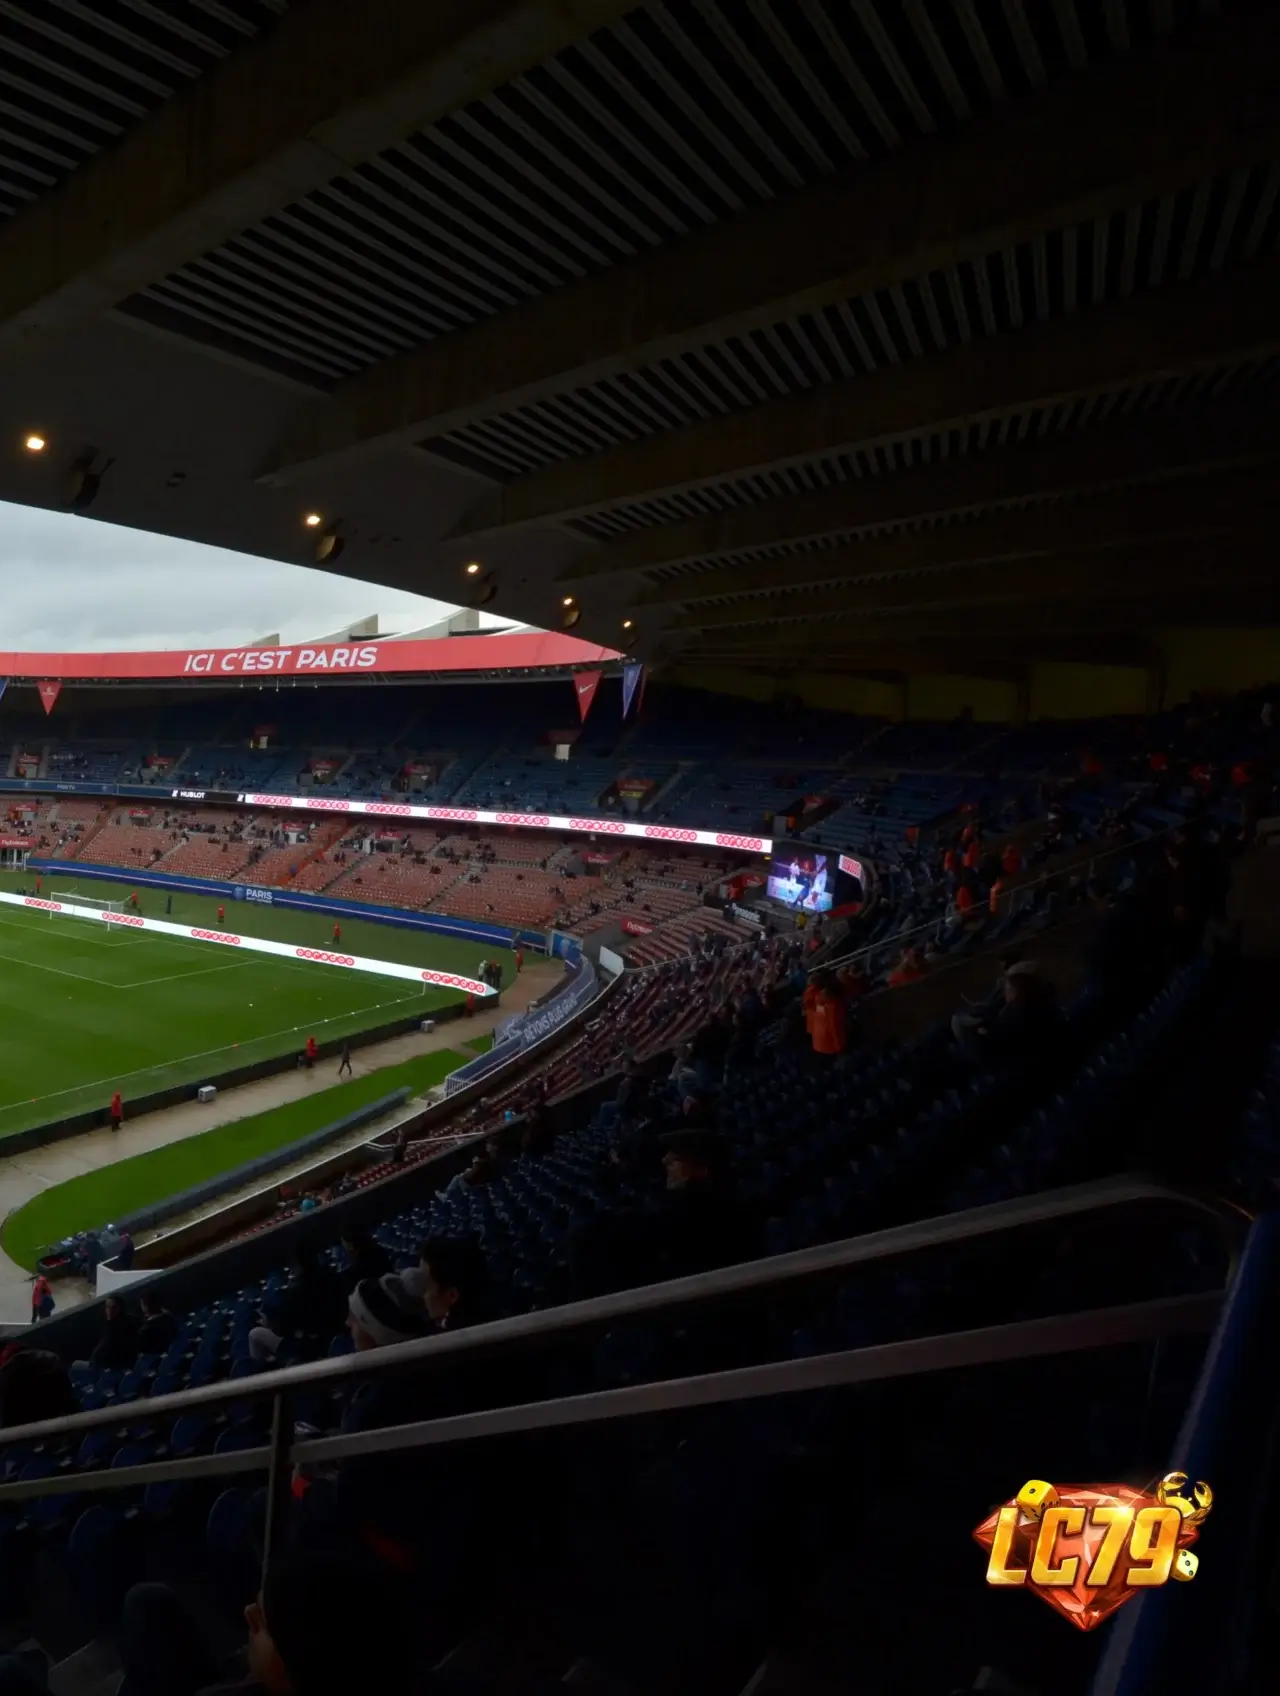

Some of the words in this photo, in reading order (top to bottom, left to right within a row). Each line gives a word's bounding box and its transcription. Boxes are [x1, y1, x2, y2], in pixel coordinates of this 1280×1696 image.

[183, 653, 216, 673] ICI
[220, 650, 292, 672] C'EST
[295, 646, 379, 669] PARIS
[180, 790, 205, 799] HUBLOT
[245, 887, 273, 900] PARIS
[24, 896, 62, 911] ooredoo
[101, 911, 144, 927] ooredoo
[190, 928, 241, 945] ooredoo
[295, 947, 355, 967] ooredoo
[421, 970, 486, 995] ooredoo
